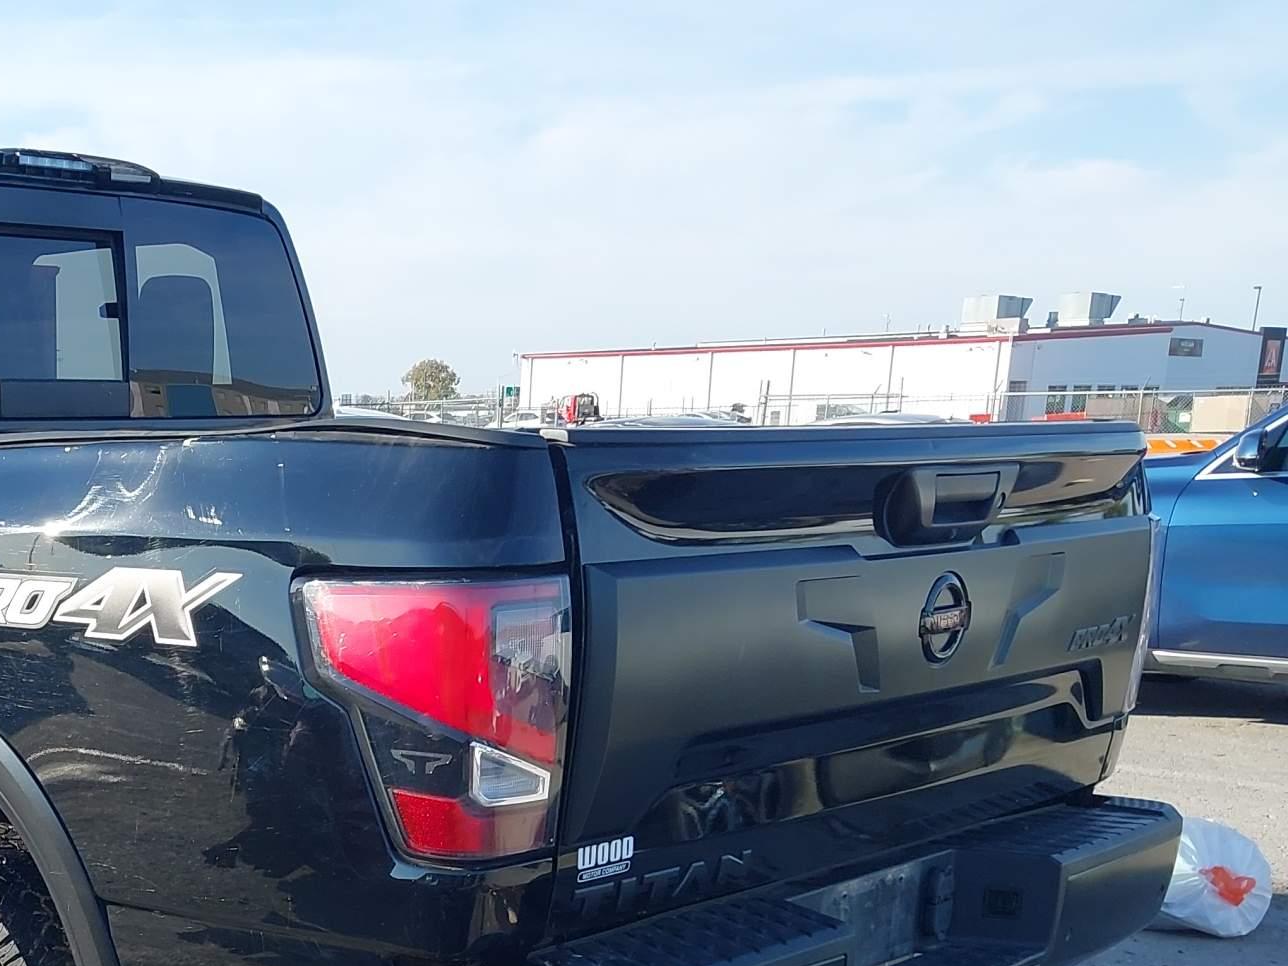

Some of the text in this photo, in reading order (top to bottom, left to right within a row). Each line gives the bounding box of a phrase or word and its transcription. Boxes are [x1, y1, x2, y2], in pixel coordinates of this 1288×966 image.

[577, 836, 634, 871] WOOD
[572, 849, 755, 916] TITAN
[582, 863, 627, 880] MOTOR COMPANY
